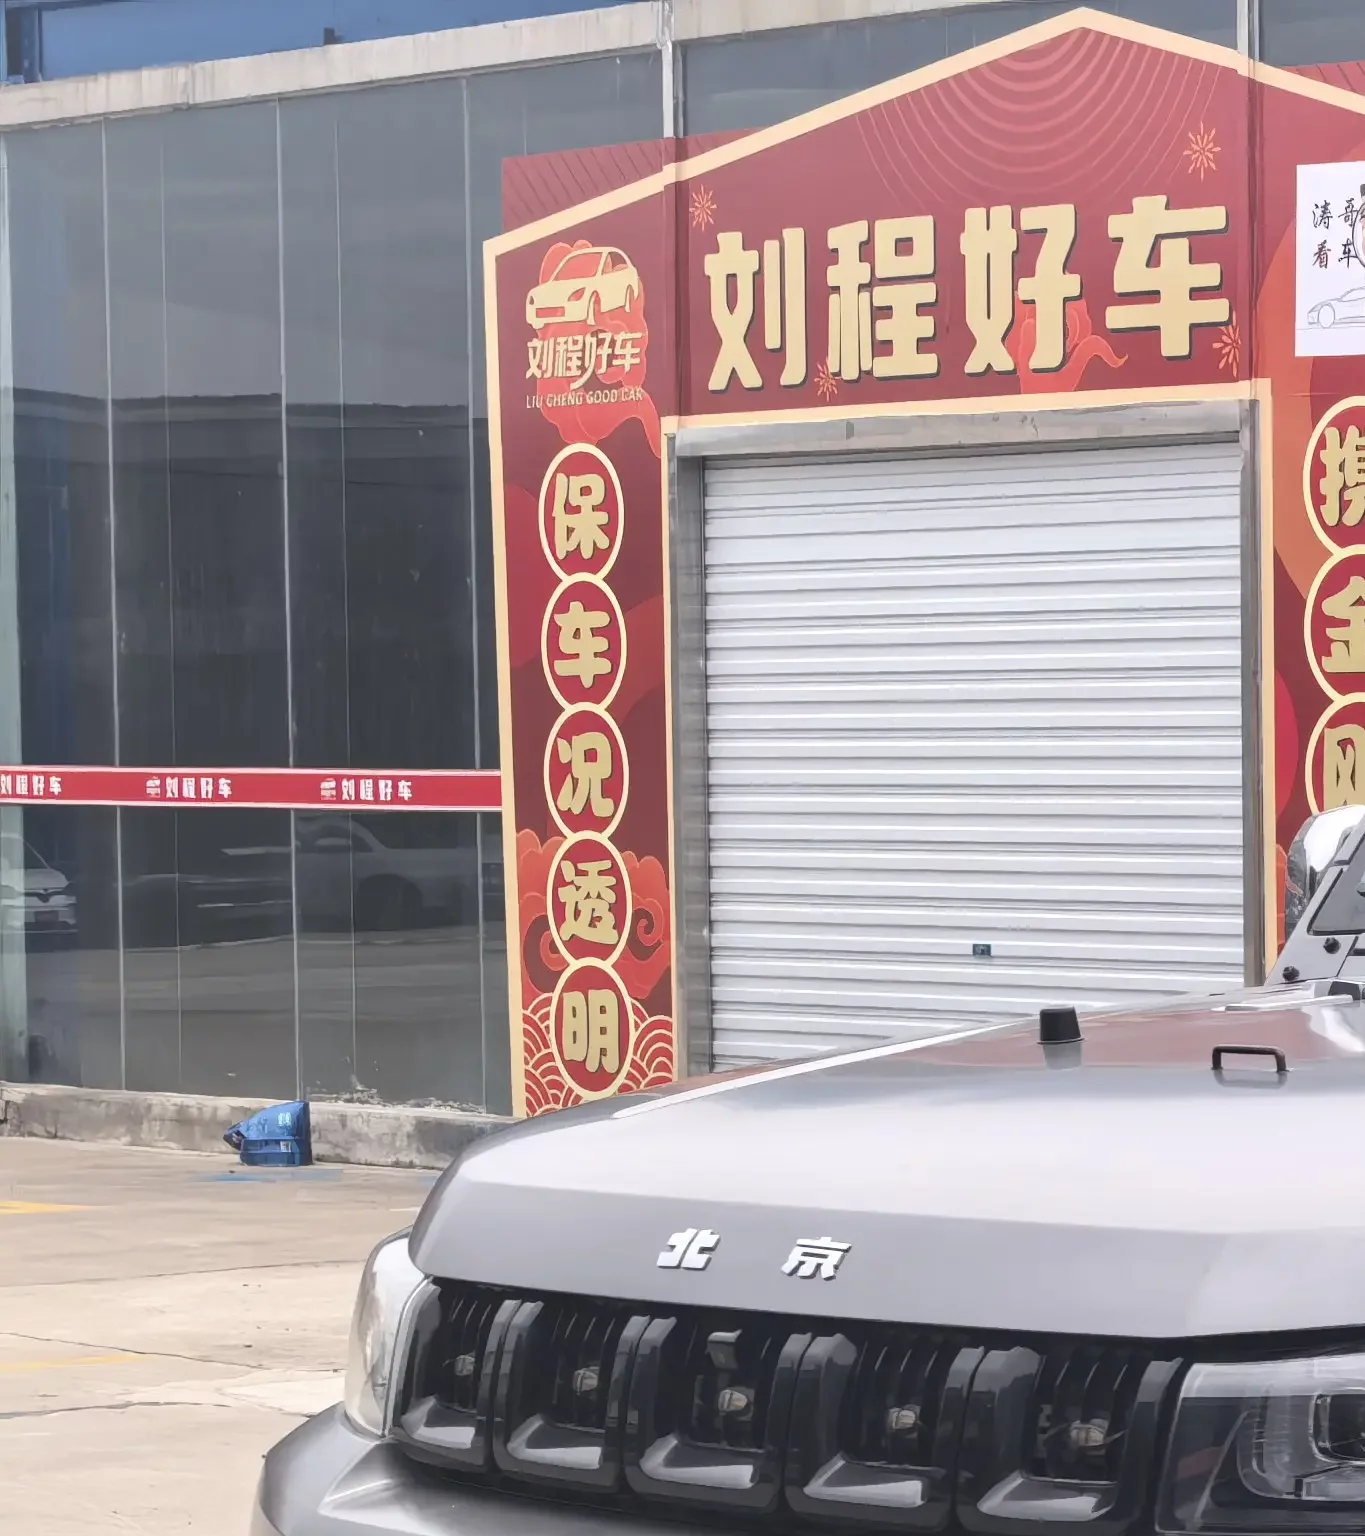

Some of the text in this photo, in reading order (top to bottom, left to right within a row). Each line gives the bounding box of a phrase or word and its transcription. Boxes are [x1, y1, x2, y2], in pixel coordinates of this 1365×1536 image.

[1312, 238, 1358, 269] 看车
[704, 195, 1231, 392] 刘程好车
[526, 331, 643, 390] 刘程好车
[526, 394, 543, 409] LIU
[586, 389, 618, 405] GOOD
[621, 387, 644, 402] CAR
[551, 471, 620, 1074] 保车况透明
[656, 1227, 852, 1281] 北京
